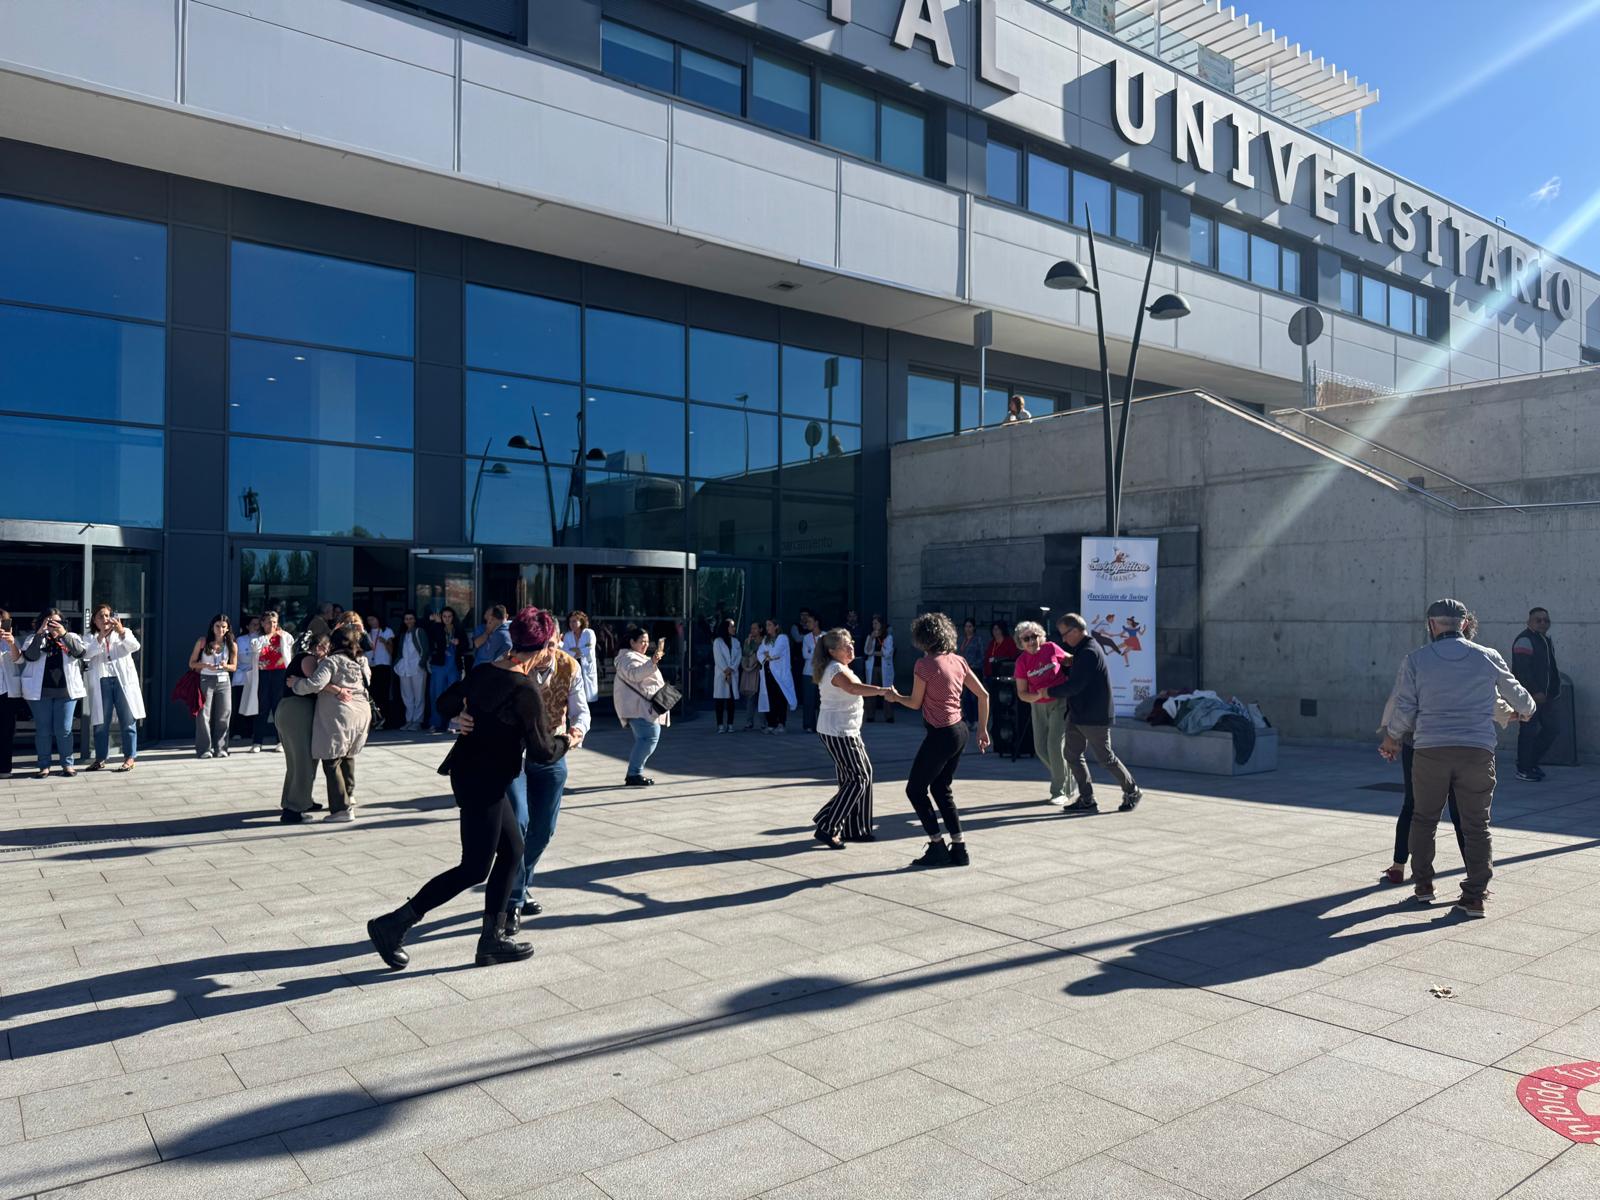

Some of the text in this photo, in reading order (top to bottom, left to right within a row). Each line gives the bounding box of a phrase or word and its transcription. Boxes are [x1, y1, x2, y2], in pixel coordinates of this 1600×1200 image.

[827, 0, 1575, 321] AL UNIVERSITARIO
[1096, 572, 1136, 582] SALAMANCA
[1128, 593, 1149, 602] Swing
[1554, 1067, 1600, 1079] fu
